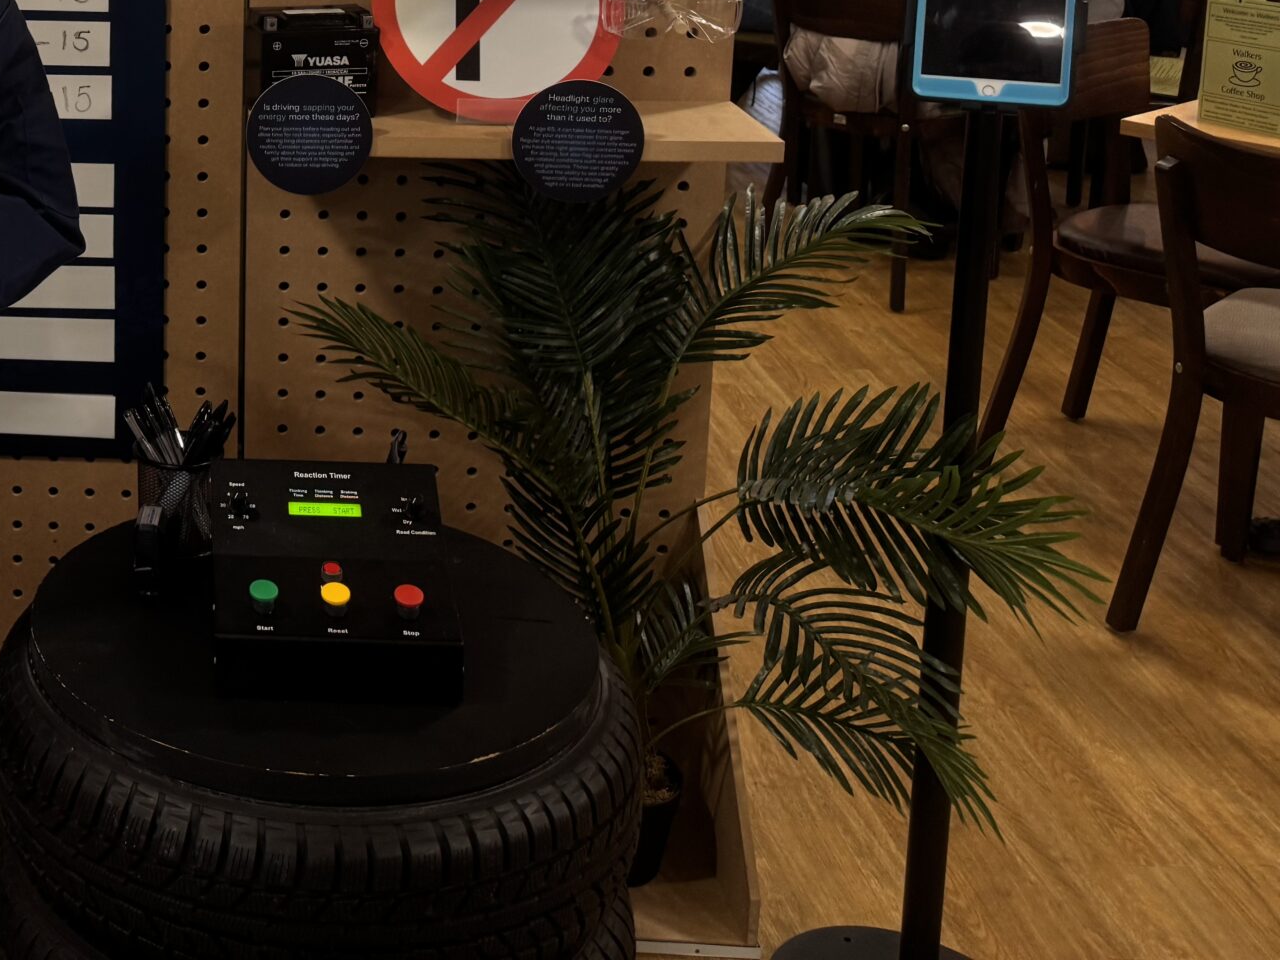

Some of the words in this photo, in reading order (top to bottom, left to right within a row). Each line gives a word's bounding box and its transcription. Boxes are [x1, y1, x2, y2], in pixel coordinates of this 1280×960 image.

[1232, 48, 1262, 61] Walkers
[307, 55, 350, 67] YUASA
[548, 93, 590, 104] Headlight
[593, 96, 615, 105] glare
[1221, 86, 1244, 98] Coffee
[1246, 89, 1265, 102] Shop
[272, 104, 300, 113] driving
[303, 105, 335, 113] sapping
[337, 105, 355, 113] your
[540, 103, 579, 113] affecting
[581, 106, 596, 114] you
[258, 114, 287, 123] energy
[312, 113, 334, 121] these
[336, 113, 360, 122] days?
[547, 113, 566, 122] than
[568, 114, 573, 122] it
[575, 114, 596, 123] used
[598, 115, 613, 124] to?
[293, 471, 327, 479] Reaction
[329, 472, 351, 480] Timer
[298, 506, 320, 514] PRESS
[332, 507, 355, 515] START
